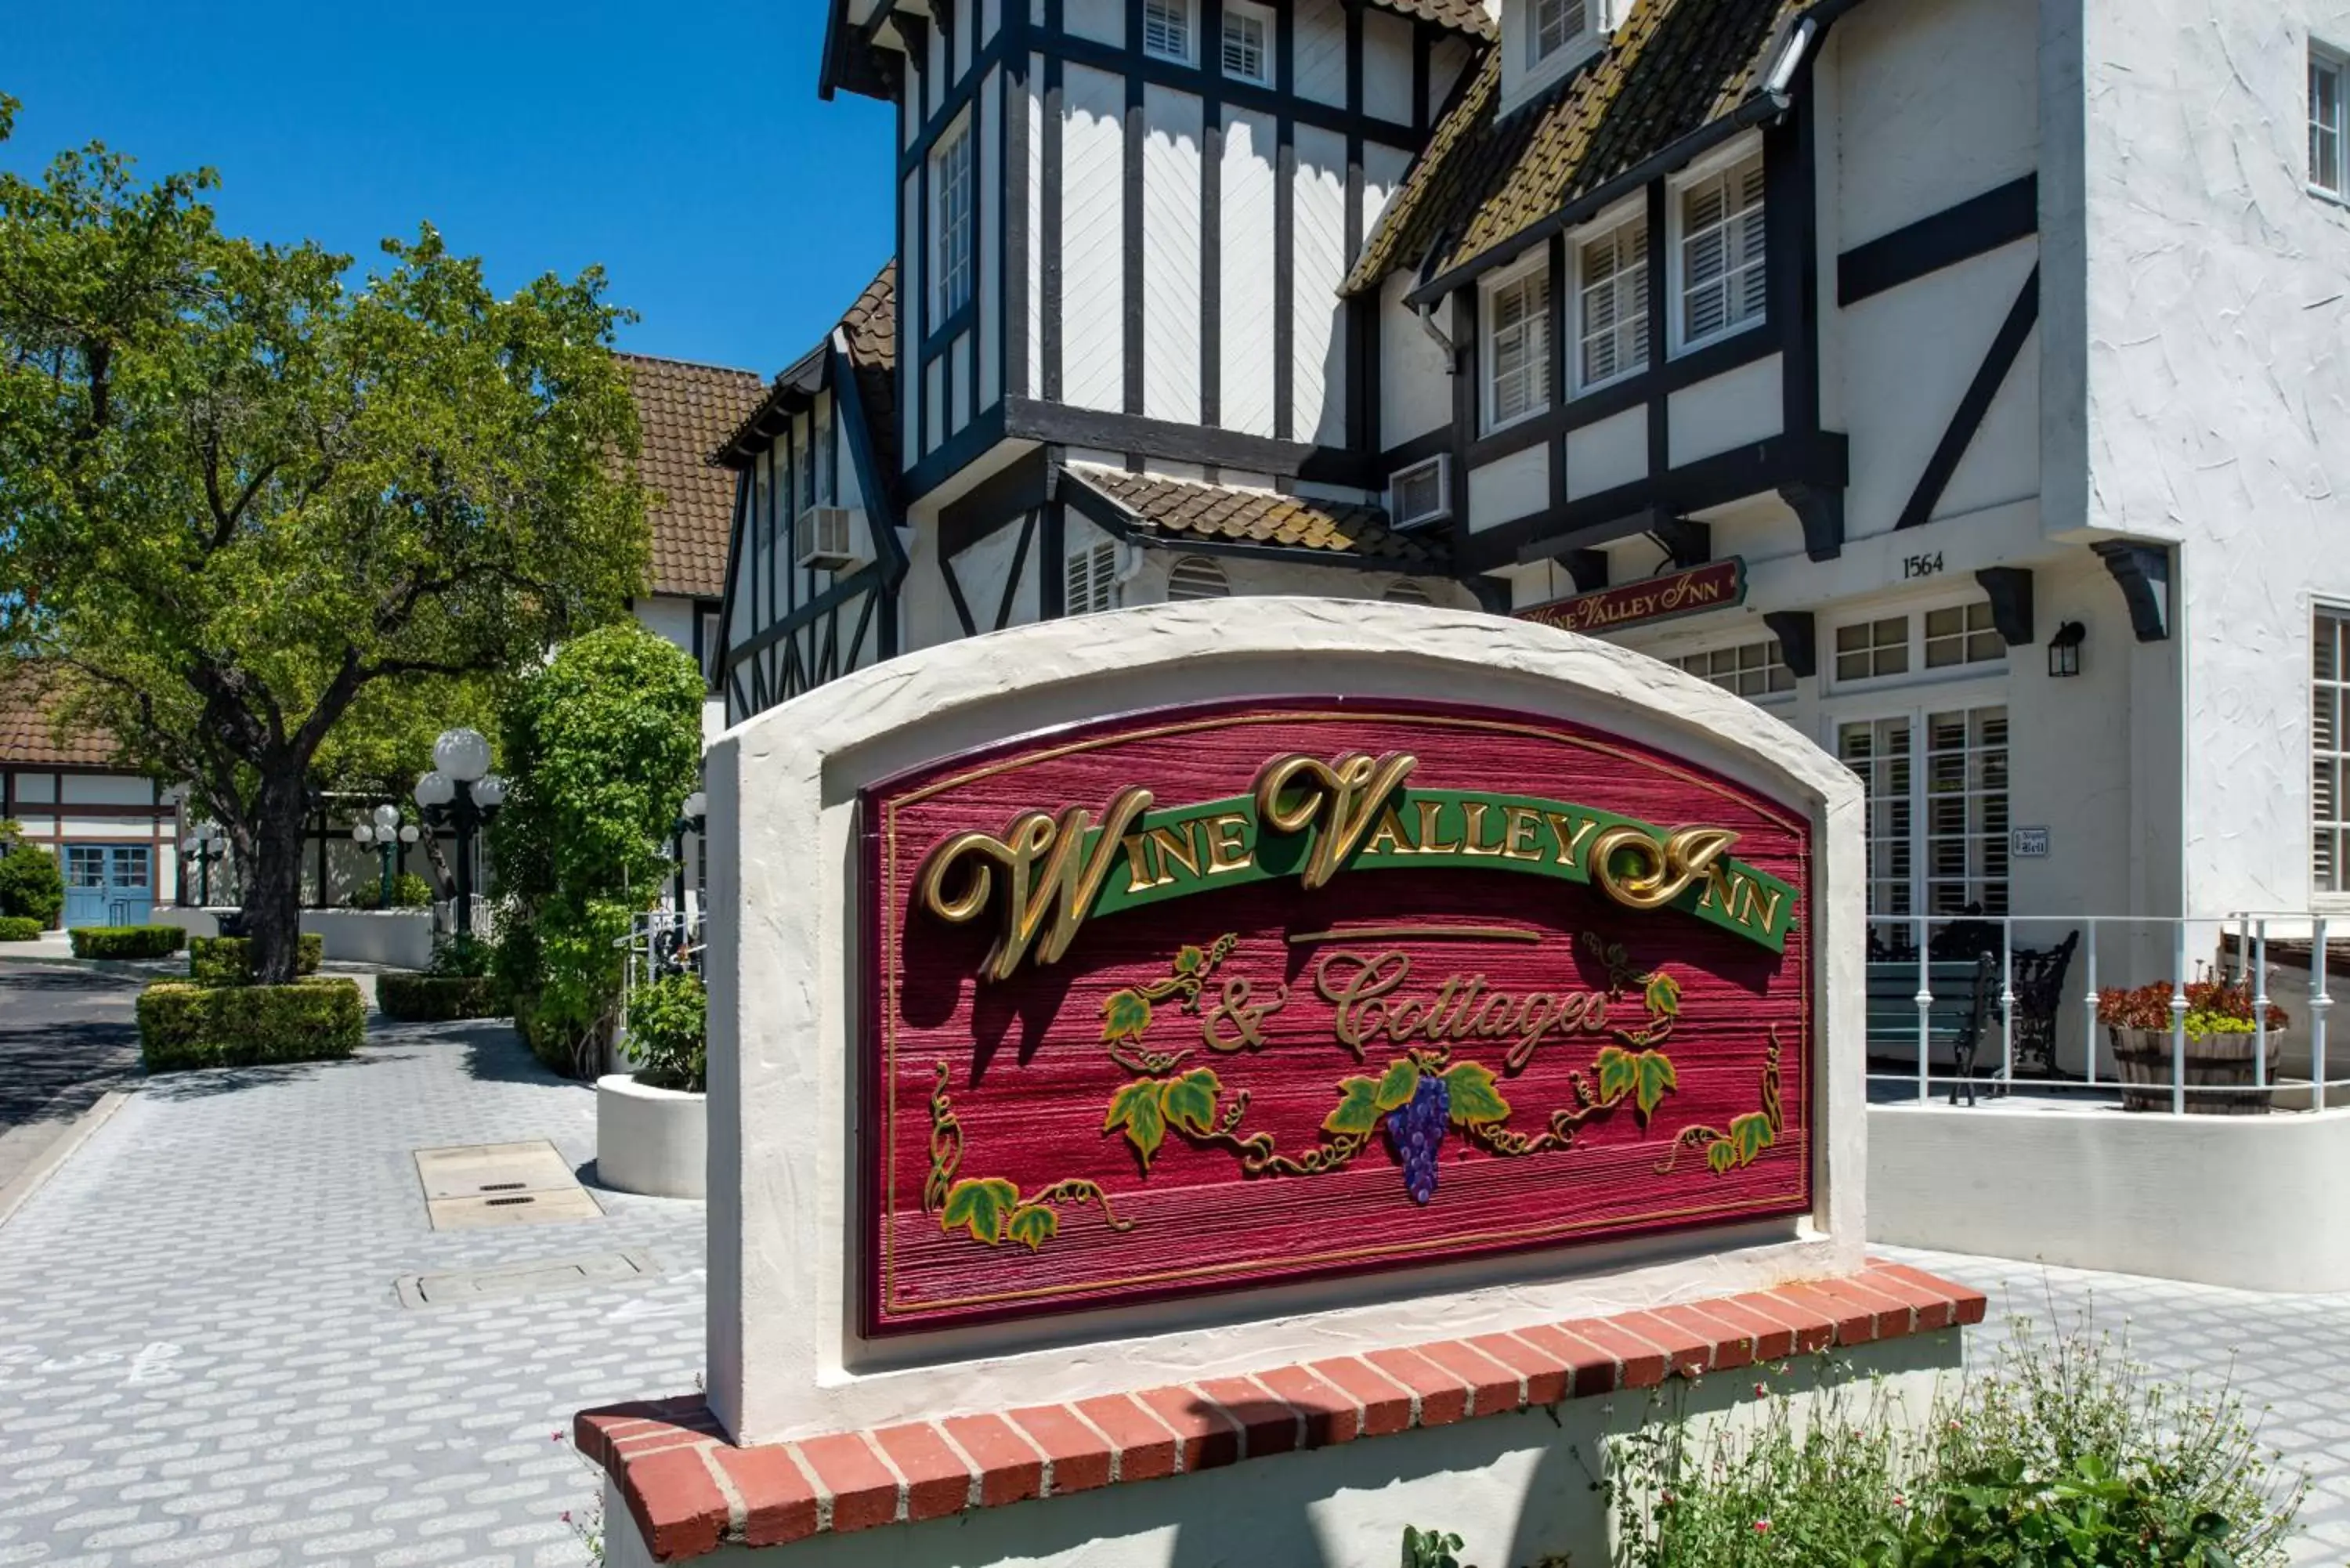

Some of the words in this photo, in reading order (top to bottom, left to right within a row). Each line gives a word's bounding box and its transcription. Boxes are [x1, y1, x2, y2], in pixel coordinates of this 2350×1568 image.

[1578, 594, 1658, 627] VALLEY
[1661, 573, 1719, 609] INN
[1904, 551, 1943, 579] 1564
[921, 786, 1255, 981] WINE
[1256, 752, 1599, 890] VALLEY
[1588, 824, 1784, 935] INN
[1203, 977, 1289, 1051] &
[1315, 951, 1612, 1069] Cottages
